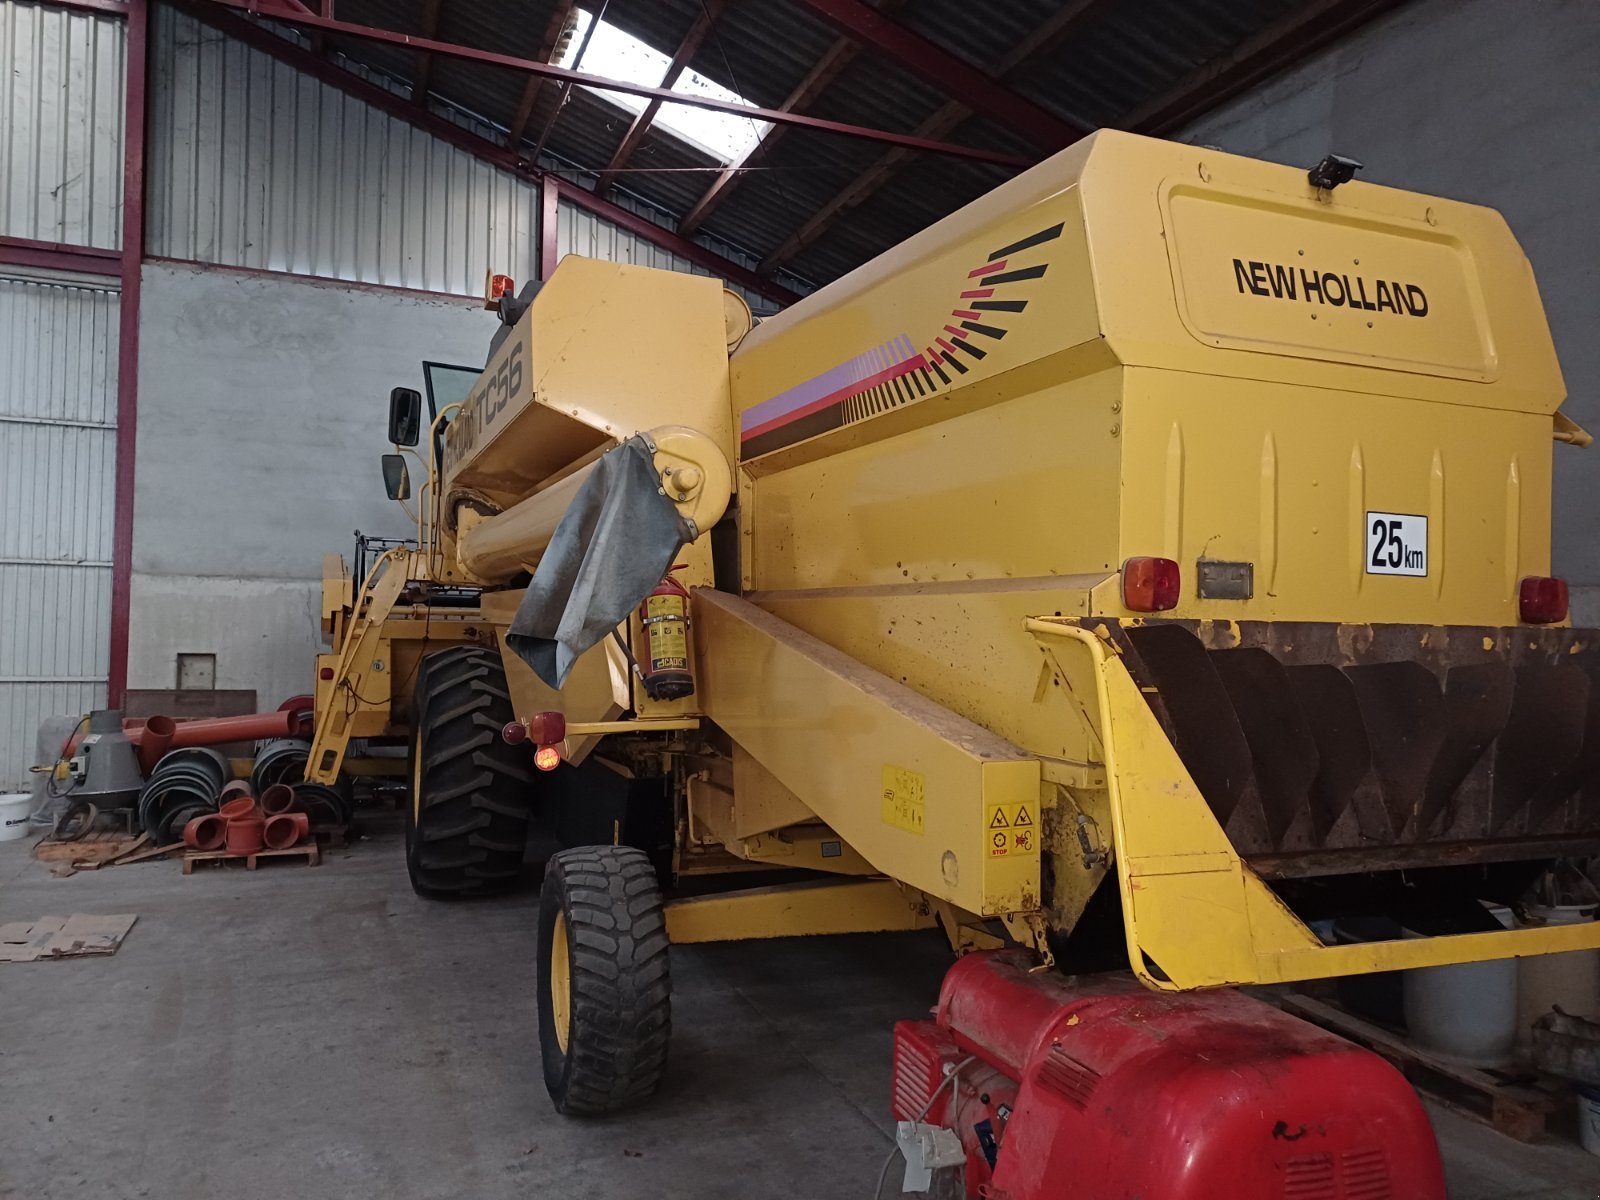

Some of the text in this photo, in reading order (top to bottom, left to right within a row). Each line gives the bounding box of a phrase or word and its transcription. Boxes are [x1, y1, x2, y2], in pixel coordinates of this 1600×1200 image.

[1233, 258, 1429, 318] NEW HOLLAND
[476, 340, 523, 435] TC56
[1371, 519, 1424, 569] 25 km
[992, 848, 1008, 856] STOP
